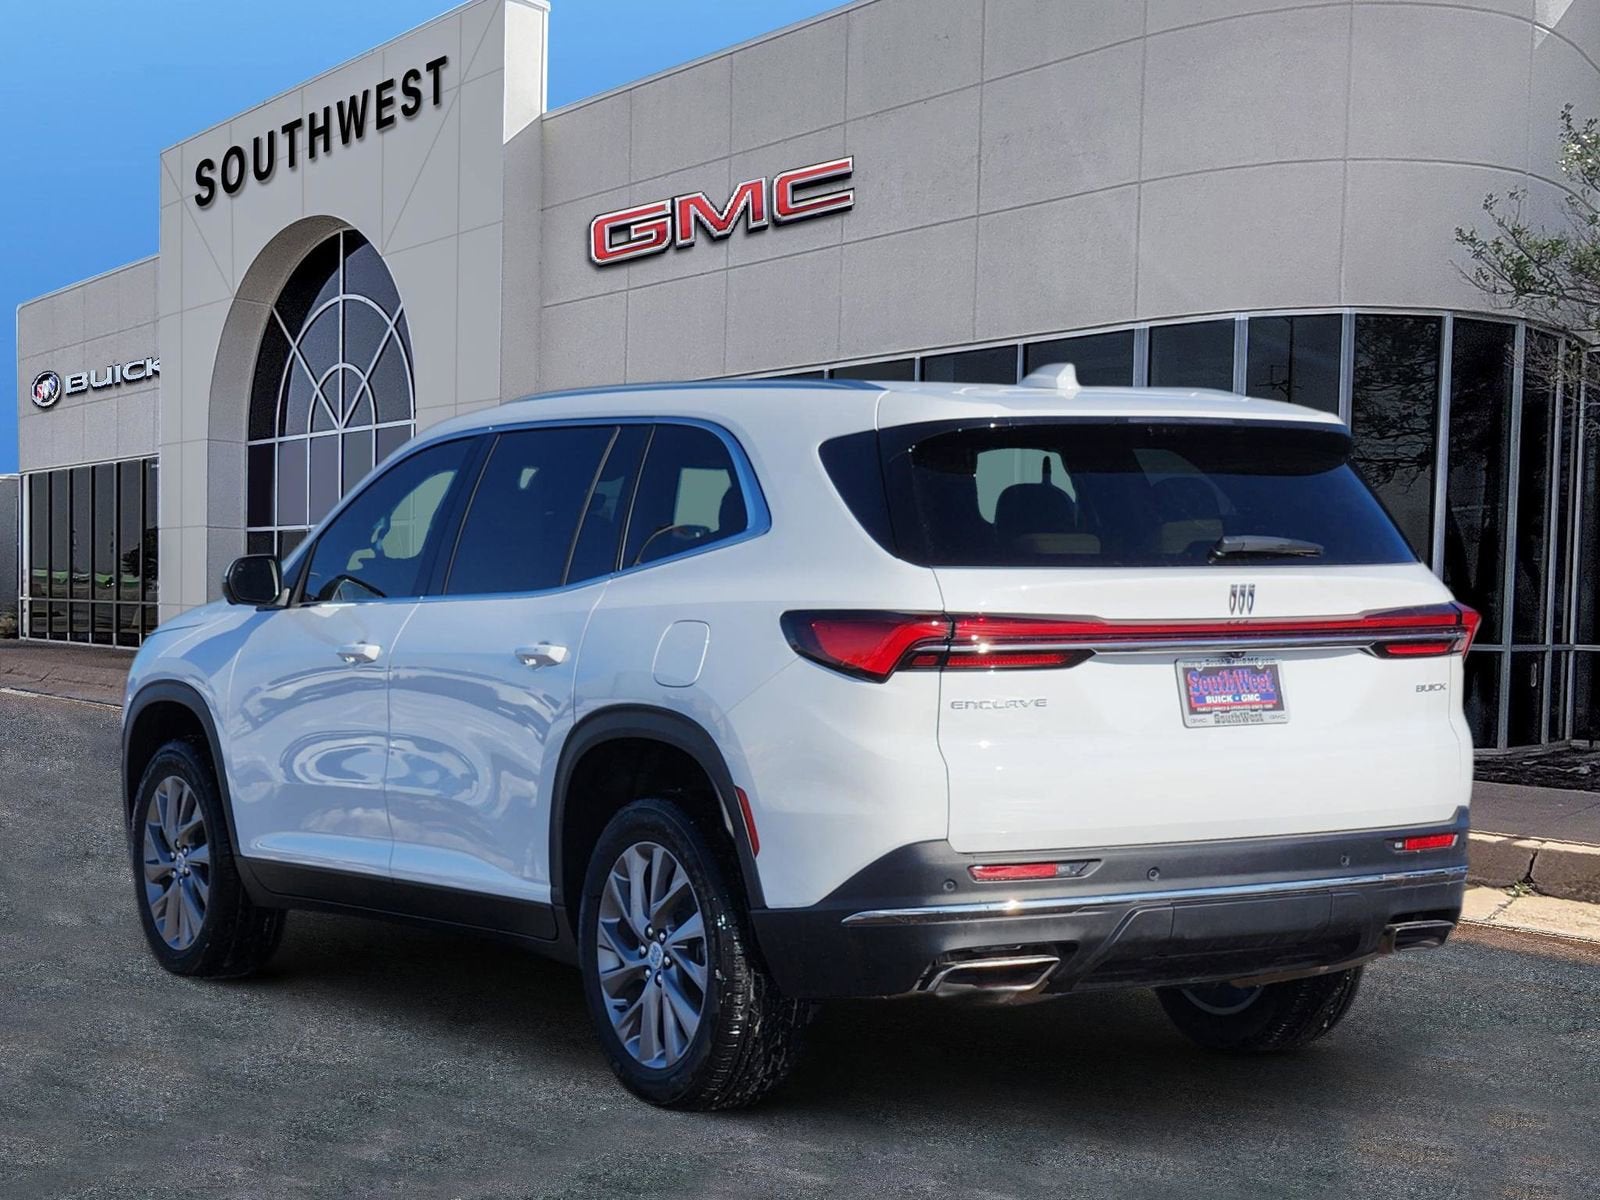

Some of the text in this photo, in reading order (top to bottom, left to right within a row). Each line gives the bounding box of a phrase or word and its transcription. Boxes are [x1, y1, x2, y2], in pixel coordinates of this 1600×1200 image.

[194, 55, 447, 207] SOUTHWEST
[589, 155, 855, 266] GMC
[65, 357, 160, 395] BUICK
[1187, 668, 1275, 696] SouthWest
[1415, 682, 1447, 693] BUICK
[950, 698, 1048, 710] ENCLAVE
[1205, 693, 1261, 704] BUICK GMC
